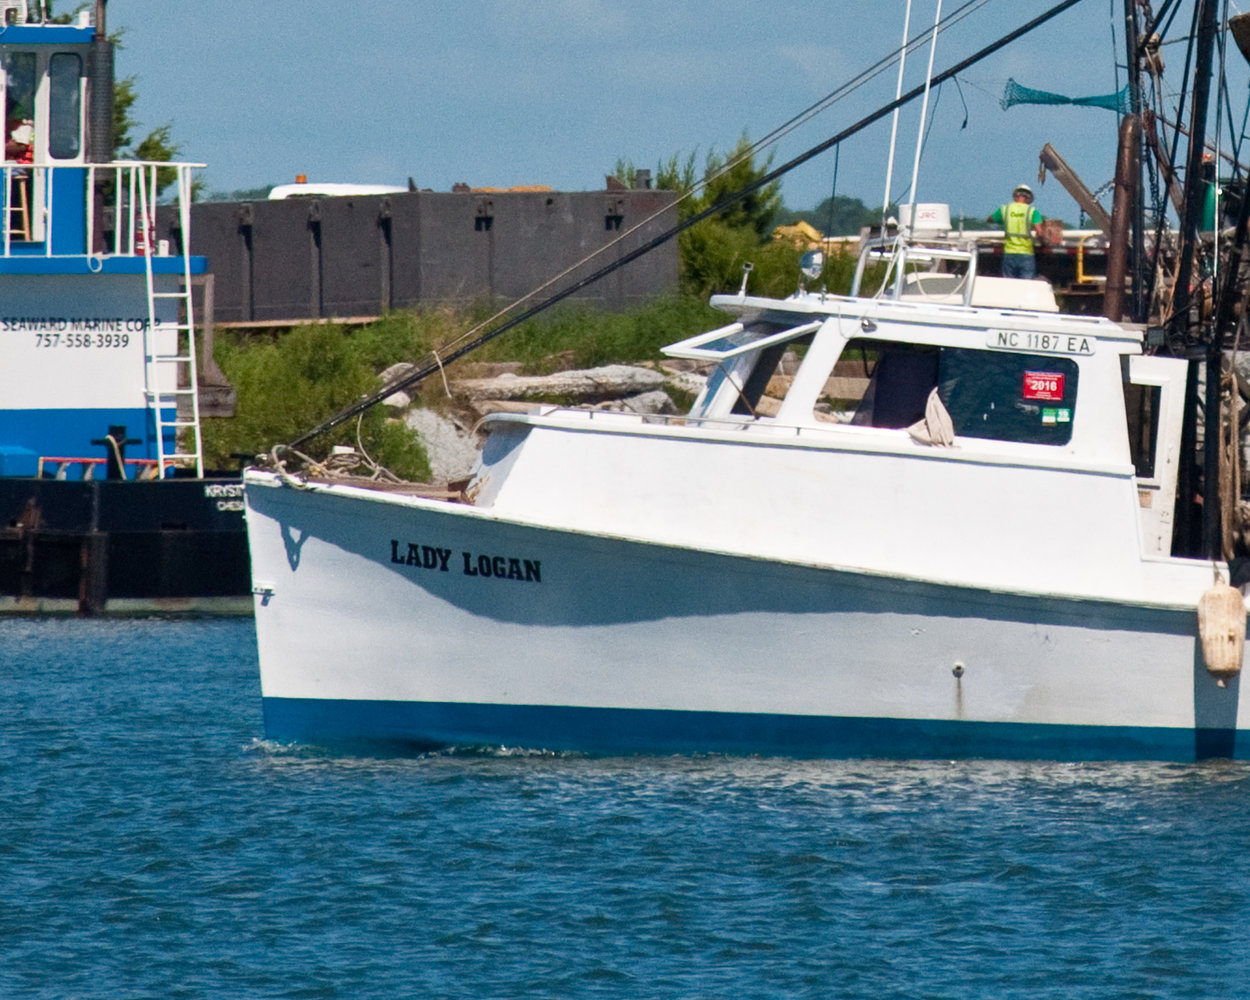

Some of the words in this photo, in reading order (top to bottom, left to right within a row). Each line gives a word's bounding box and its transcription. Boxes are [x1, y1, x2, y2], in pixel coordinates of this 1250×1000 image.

[2, 317, 67, 332] SEAWARD
[70, 317, 123, 332] MARINE
[35, 333, 130, 348] 757-558-3939
[997, 332, 1019, 347] NC
[1027, 333, 1060, 350] 1187
[1067, 337, 1091, 353] EA
[390, 539, 452, 572] LADY
[461, 552, 543, 583] LOGAN
